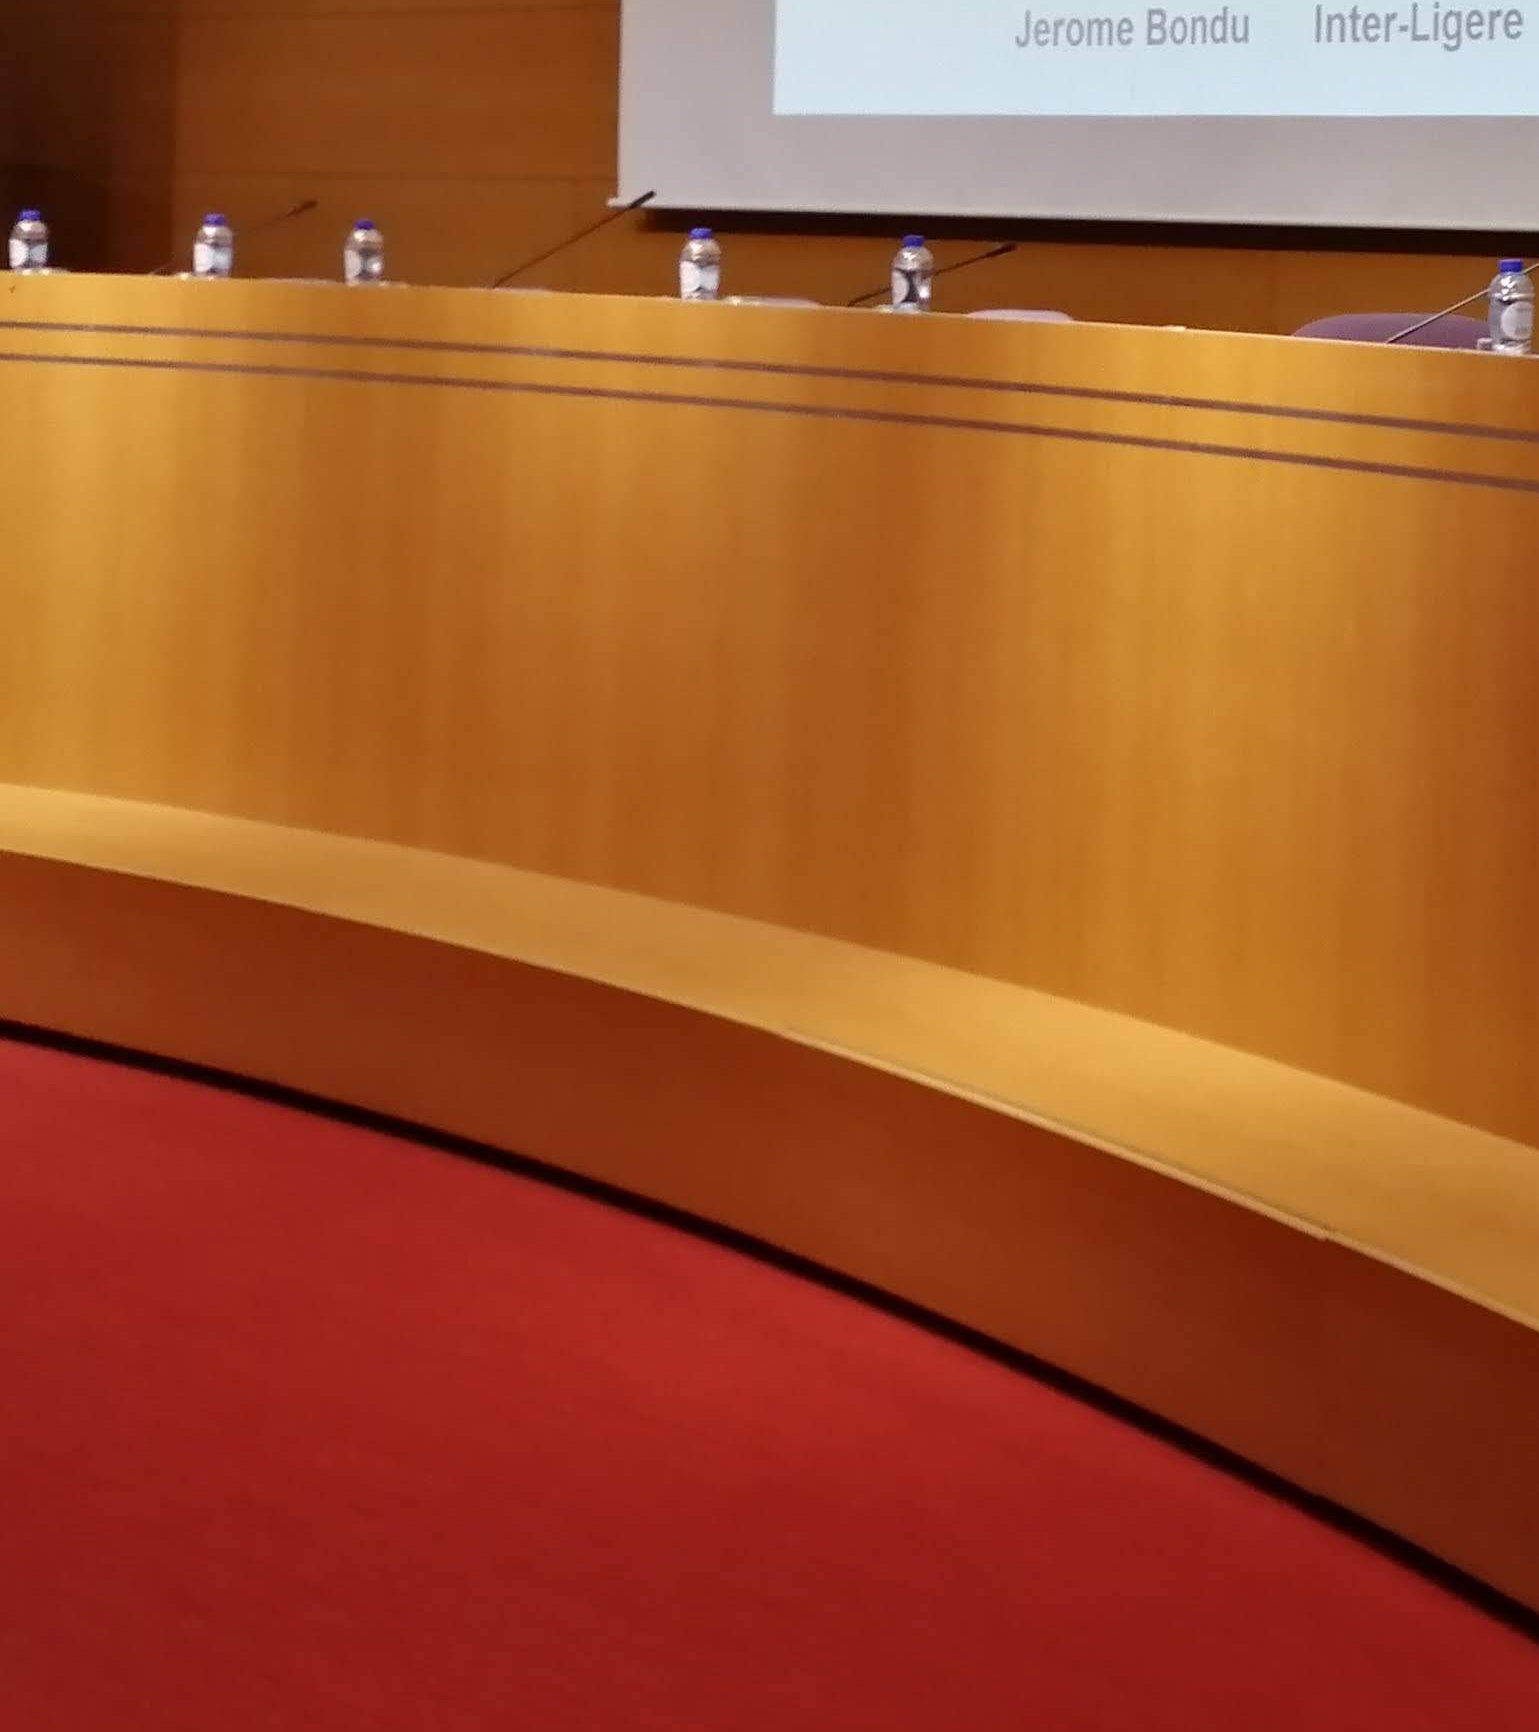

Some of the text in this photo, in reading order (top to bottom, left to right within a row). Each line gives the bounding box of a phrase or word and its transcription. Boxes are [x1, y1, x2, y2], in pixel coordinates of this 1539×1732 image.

[1015, 1, 1525, 52] Jerome Bondu Inter-Ligere
